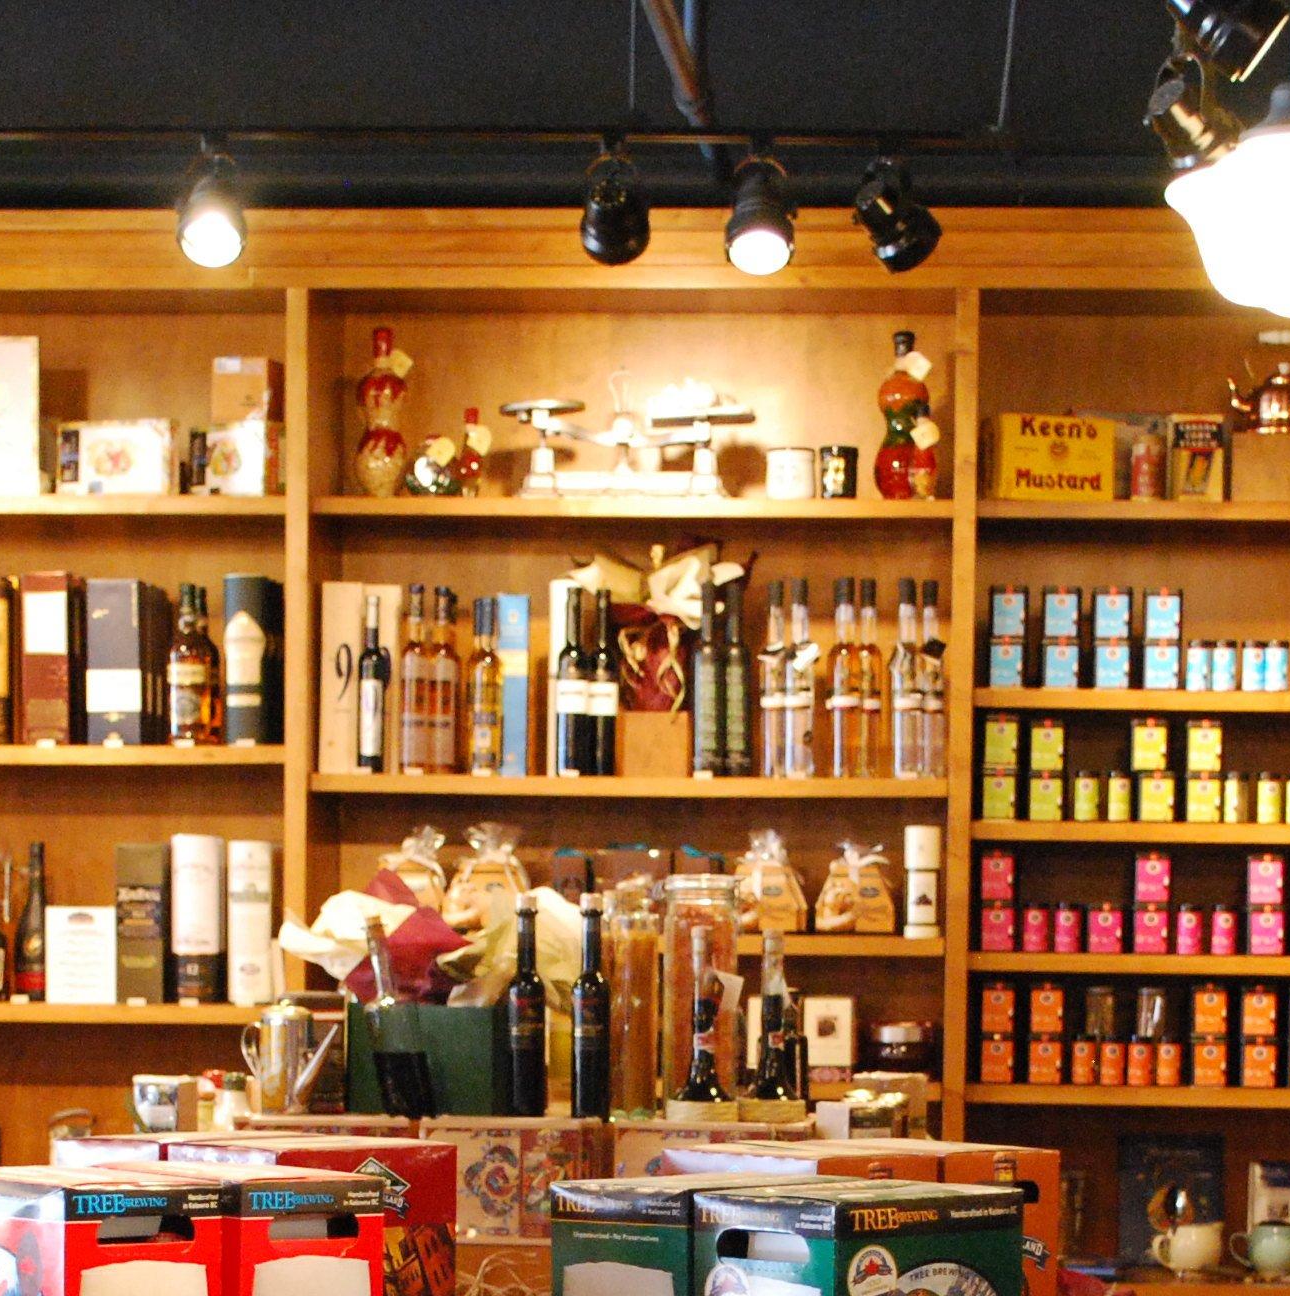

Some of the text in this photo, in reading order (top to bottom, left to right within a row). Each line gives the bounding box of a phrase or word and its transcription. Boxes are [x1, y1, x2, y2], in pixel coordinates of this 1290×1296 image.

[1020, 416, 1097, 440] Keen's
[1015, 468, 1103, 491] Mustard
[73, 1194, 168, 1215] TREE BREWING
[249, 1191, 335, 1211] TREE BREWING
[557, 1195, 596, 1215] TREE
[701, 1206, 740, 1225] TREE
[850, 1207, 938, 1231] TREE BREWING
